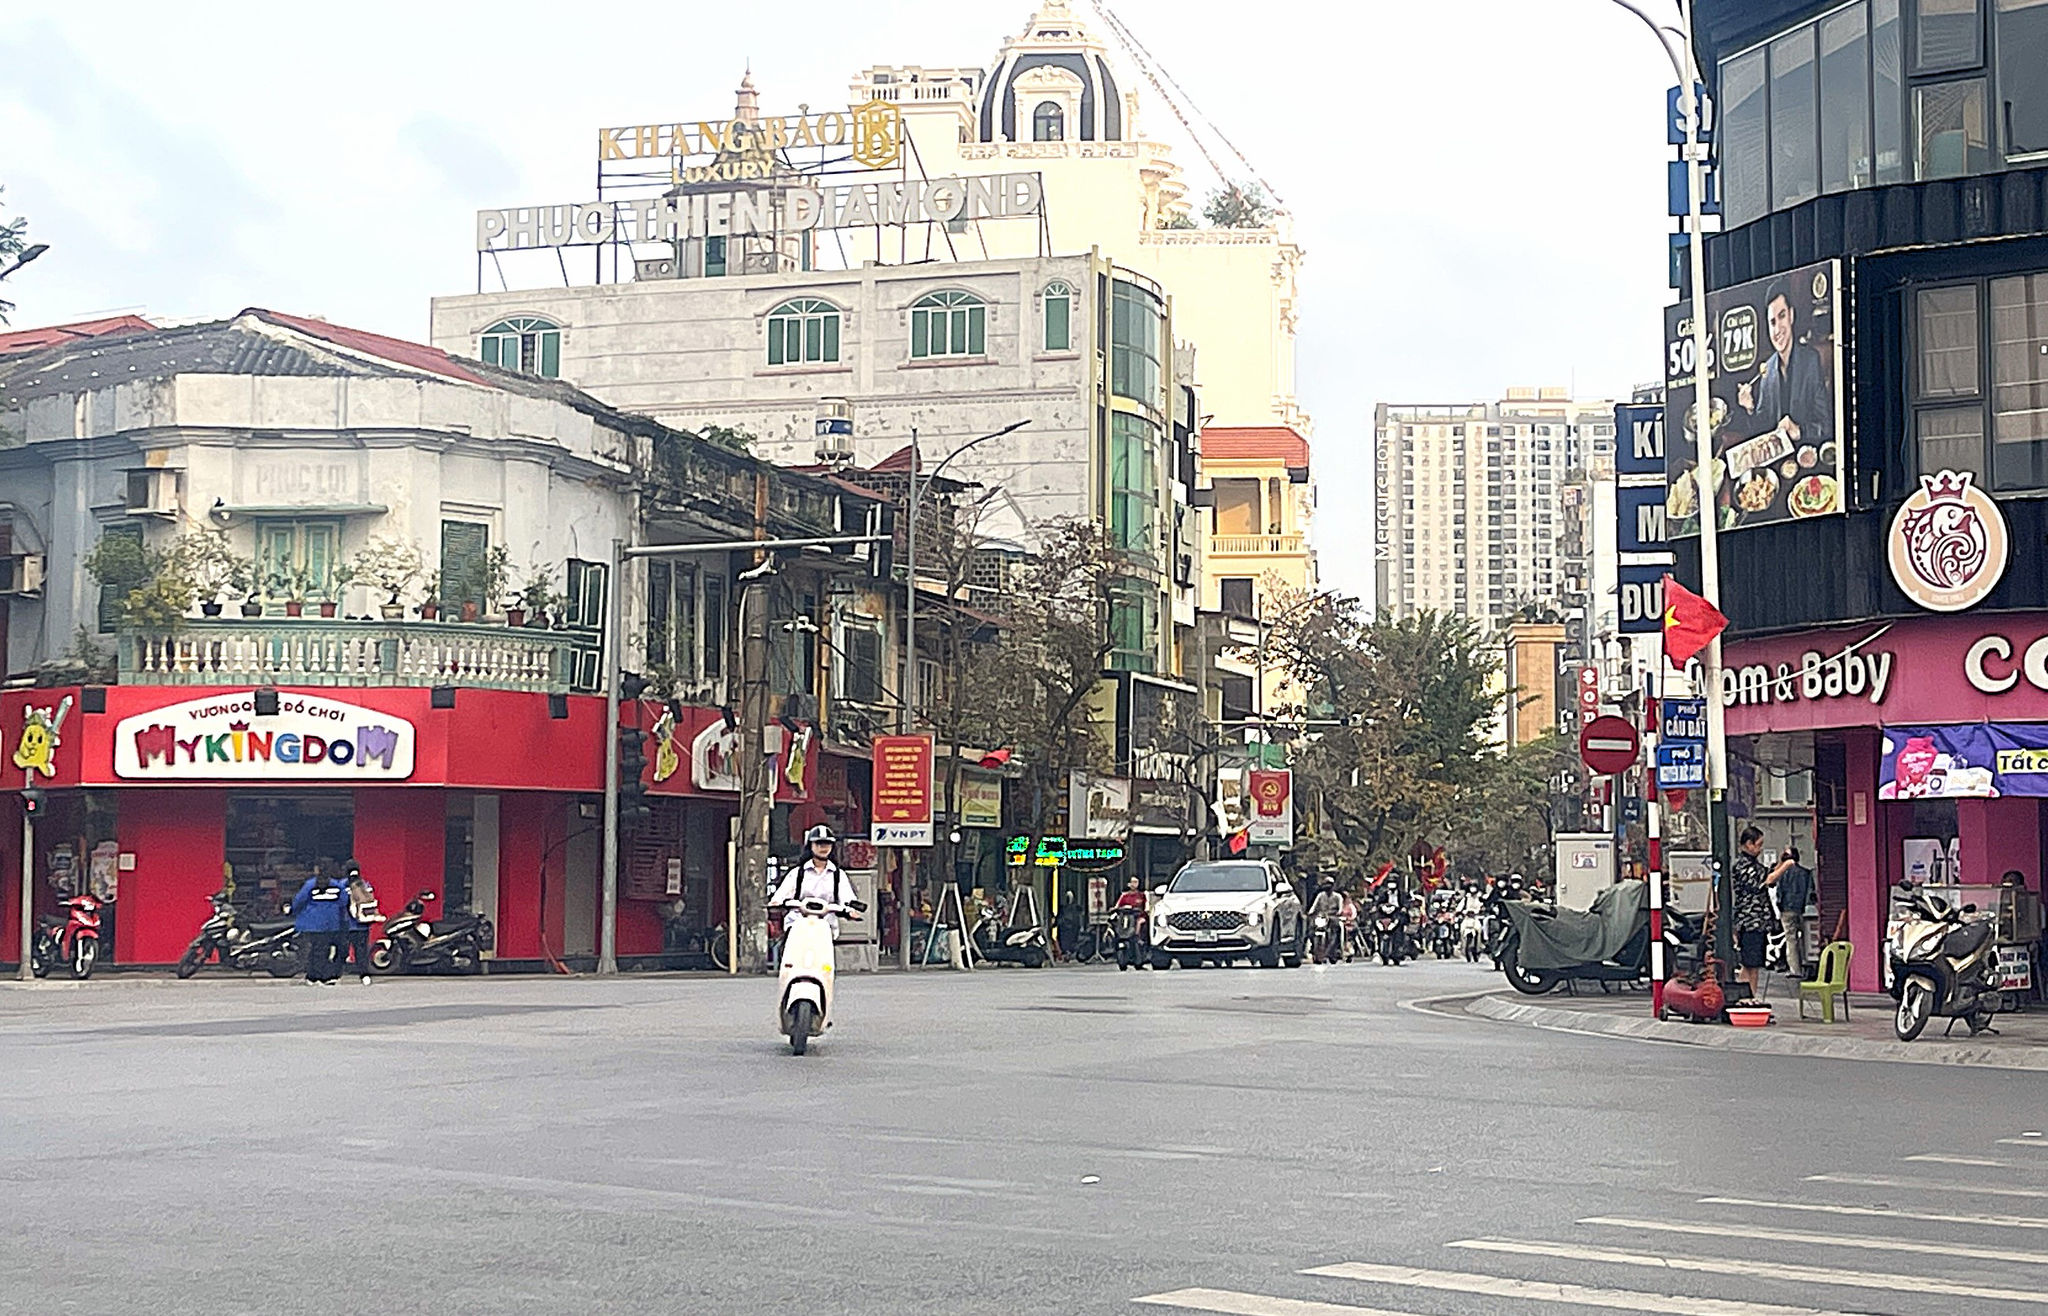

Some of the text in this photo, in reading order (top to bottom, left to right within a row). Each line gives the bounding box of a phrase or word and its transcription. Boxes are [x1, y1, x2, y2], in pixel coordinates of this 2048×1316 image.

[599, 103, 845, 160] KHANG BẢO
[672, 159, 776, 185] LUXURY
[477, 172, 1041, 251] PHUC THIEN DIAMOND
[1723, 325, 1755, 354] 79K
[1376, 476, 1389, 560] Mercure
[1775, 664, 1794, 701] &
[1802, 647, 1892, 703] Baby
[890, 830, 927, 838] VNPT
